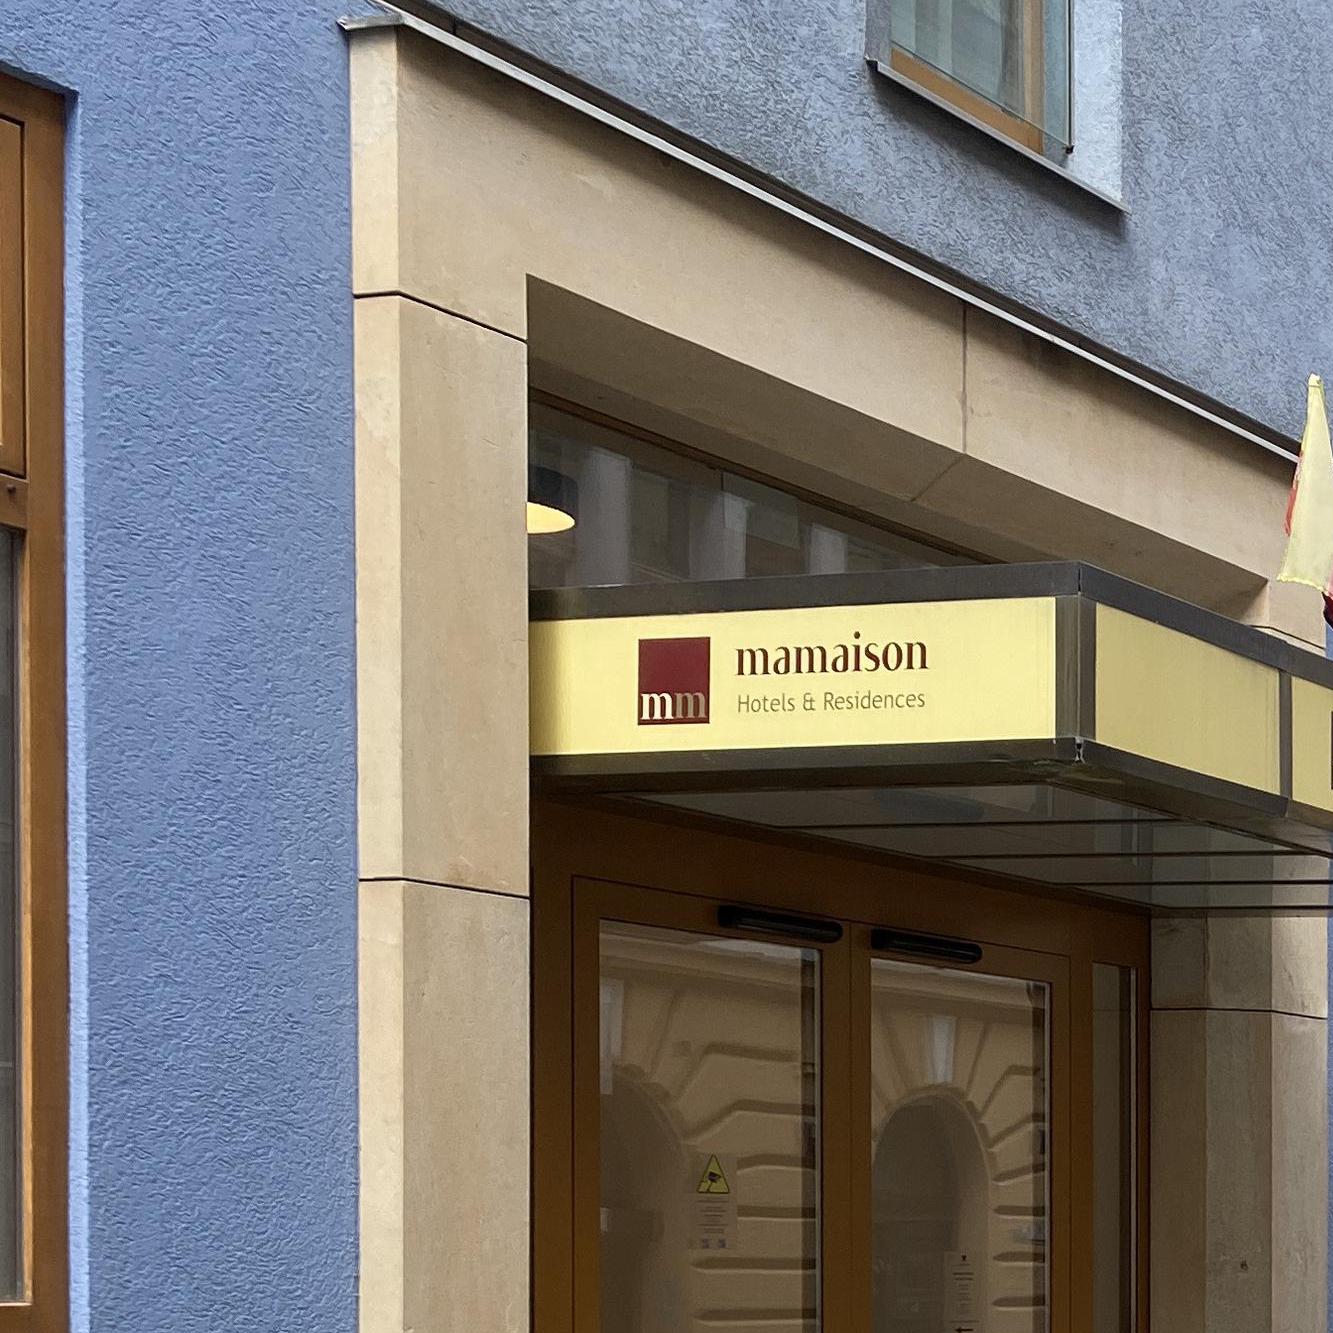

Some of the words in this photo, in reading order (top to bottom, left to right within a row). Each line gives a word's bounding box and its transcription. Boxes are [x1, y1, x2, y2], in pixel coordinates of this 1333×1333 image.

[735, 631, 929, 676] mamaison
[640, 691, 707, 721] mm
[737, 693, 796, 714] Hotels
[802, 692, 816, 712] &
[823, 690, 926, 711] Residences
